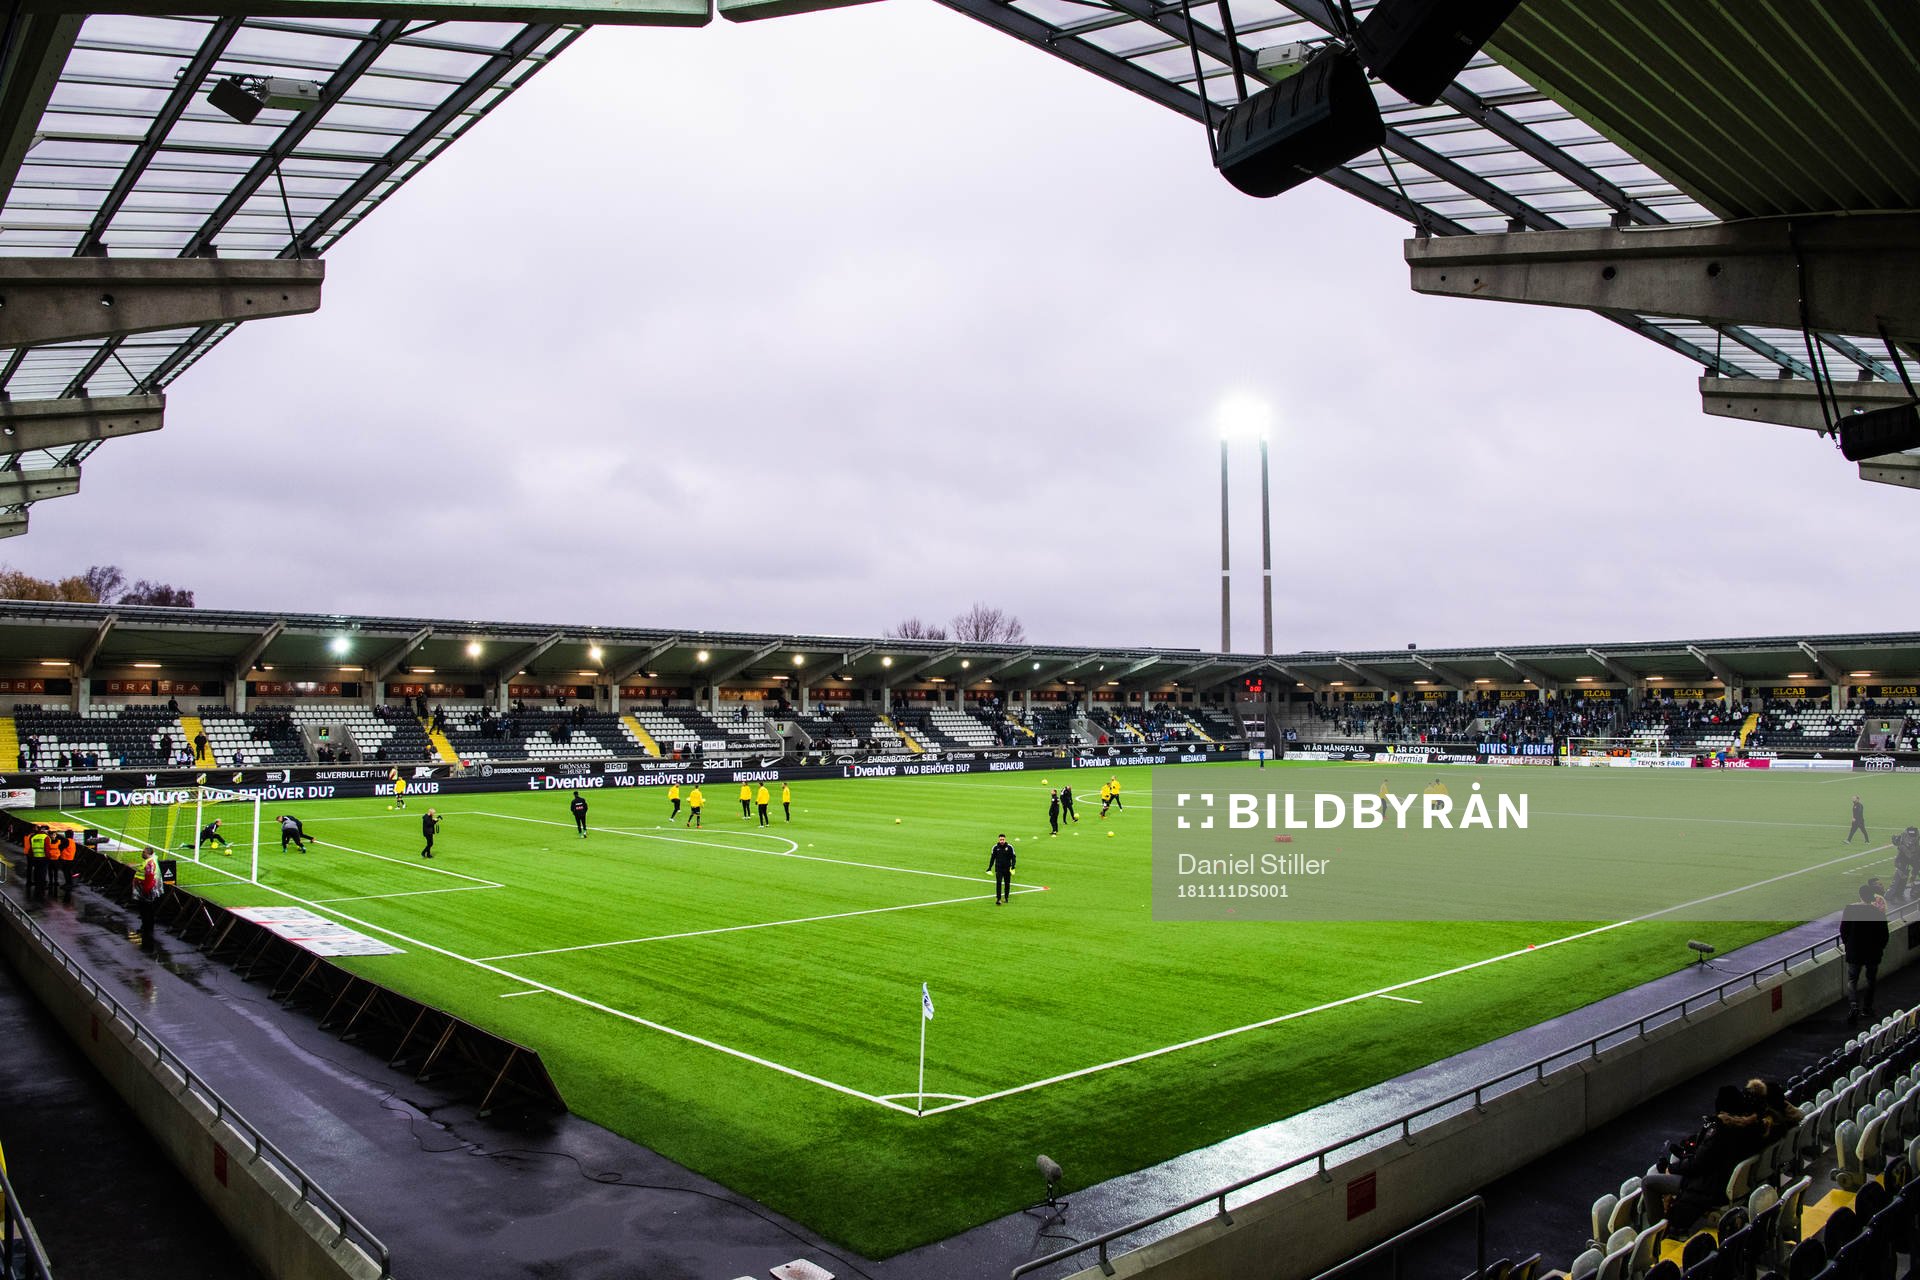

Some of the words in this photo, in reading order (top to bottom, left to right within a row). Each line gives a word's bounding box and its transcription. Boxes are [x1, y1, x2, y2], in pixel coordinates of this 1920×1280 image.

[880, 737, 902, 747] ravida
[1324, 743, 1364, 752] MÅNGFALD
[1409, 746, 1445, 754] FOTBOLL
[1480, 743, 1507, 754] DIVIS
[1523, 744, 1554, 755] IONEN
[1115, 757, 1128, 765] VAD
[1128, 755, 1154, 765] BEHÖVER
[1155, 756, 1166, 764] DU?
[1181, 754, 1207, 762] MEDIAKUB
[1388, 754, 1423, 763] Thermia
[1488, 755, 1524, 765] Prioritet
[1524, 755, 1552, 766] Finans
[1711, 759, 1750, 768] Sandic
[703, 759, 743, 769] stadium
[903, 766, 919, 775] VAD
[920, 762, 954, 774] BEHÖVER
[956, 763, 970, 773] DU?
[990, 762, 1024, 771] MEDIAKUB
[493, 767, 545, 775] BUSSBOKNING.COM
[40, 776, 69, 784] göteborgs
[614, 776, 635, 786] VAD
[638, 772, 684, 785] BEHÖVER
[686, 773, 705, 783] DU?
[733, 771, 779, 782] MEDIAKUB
[308, 786, 335, 798] DU?
[375, 782, 439, 796] MEIAKUB
